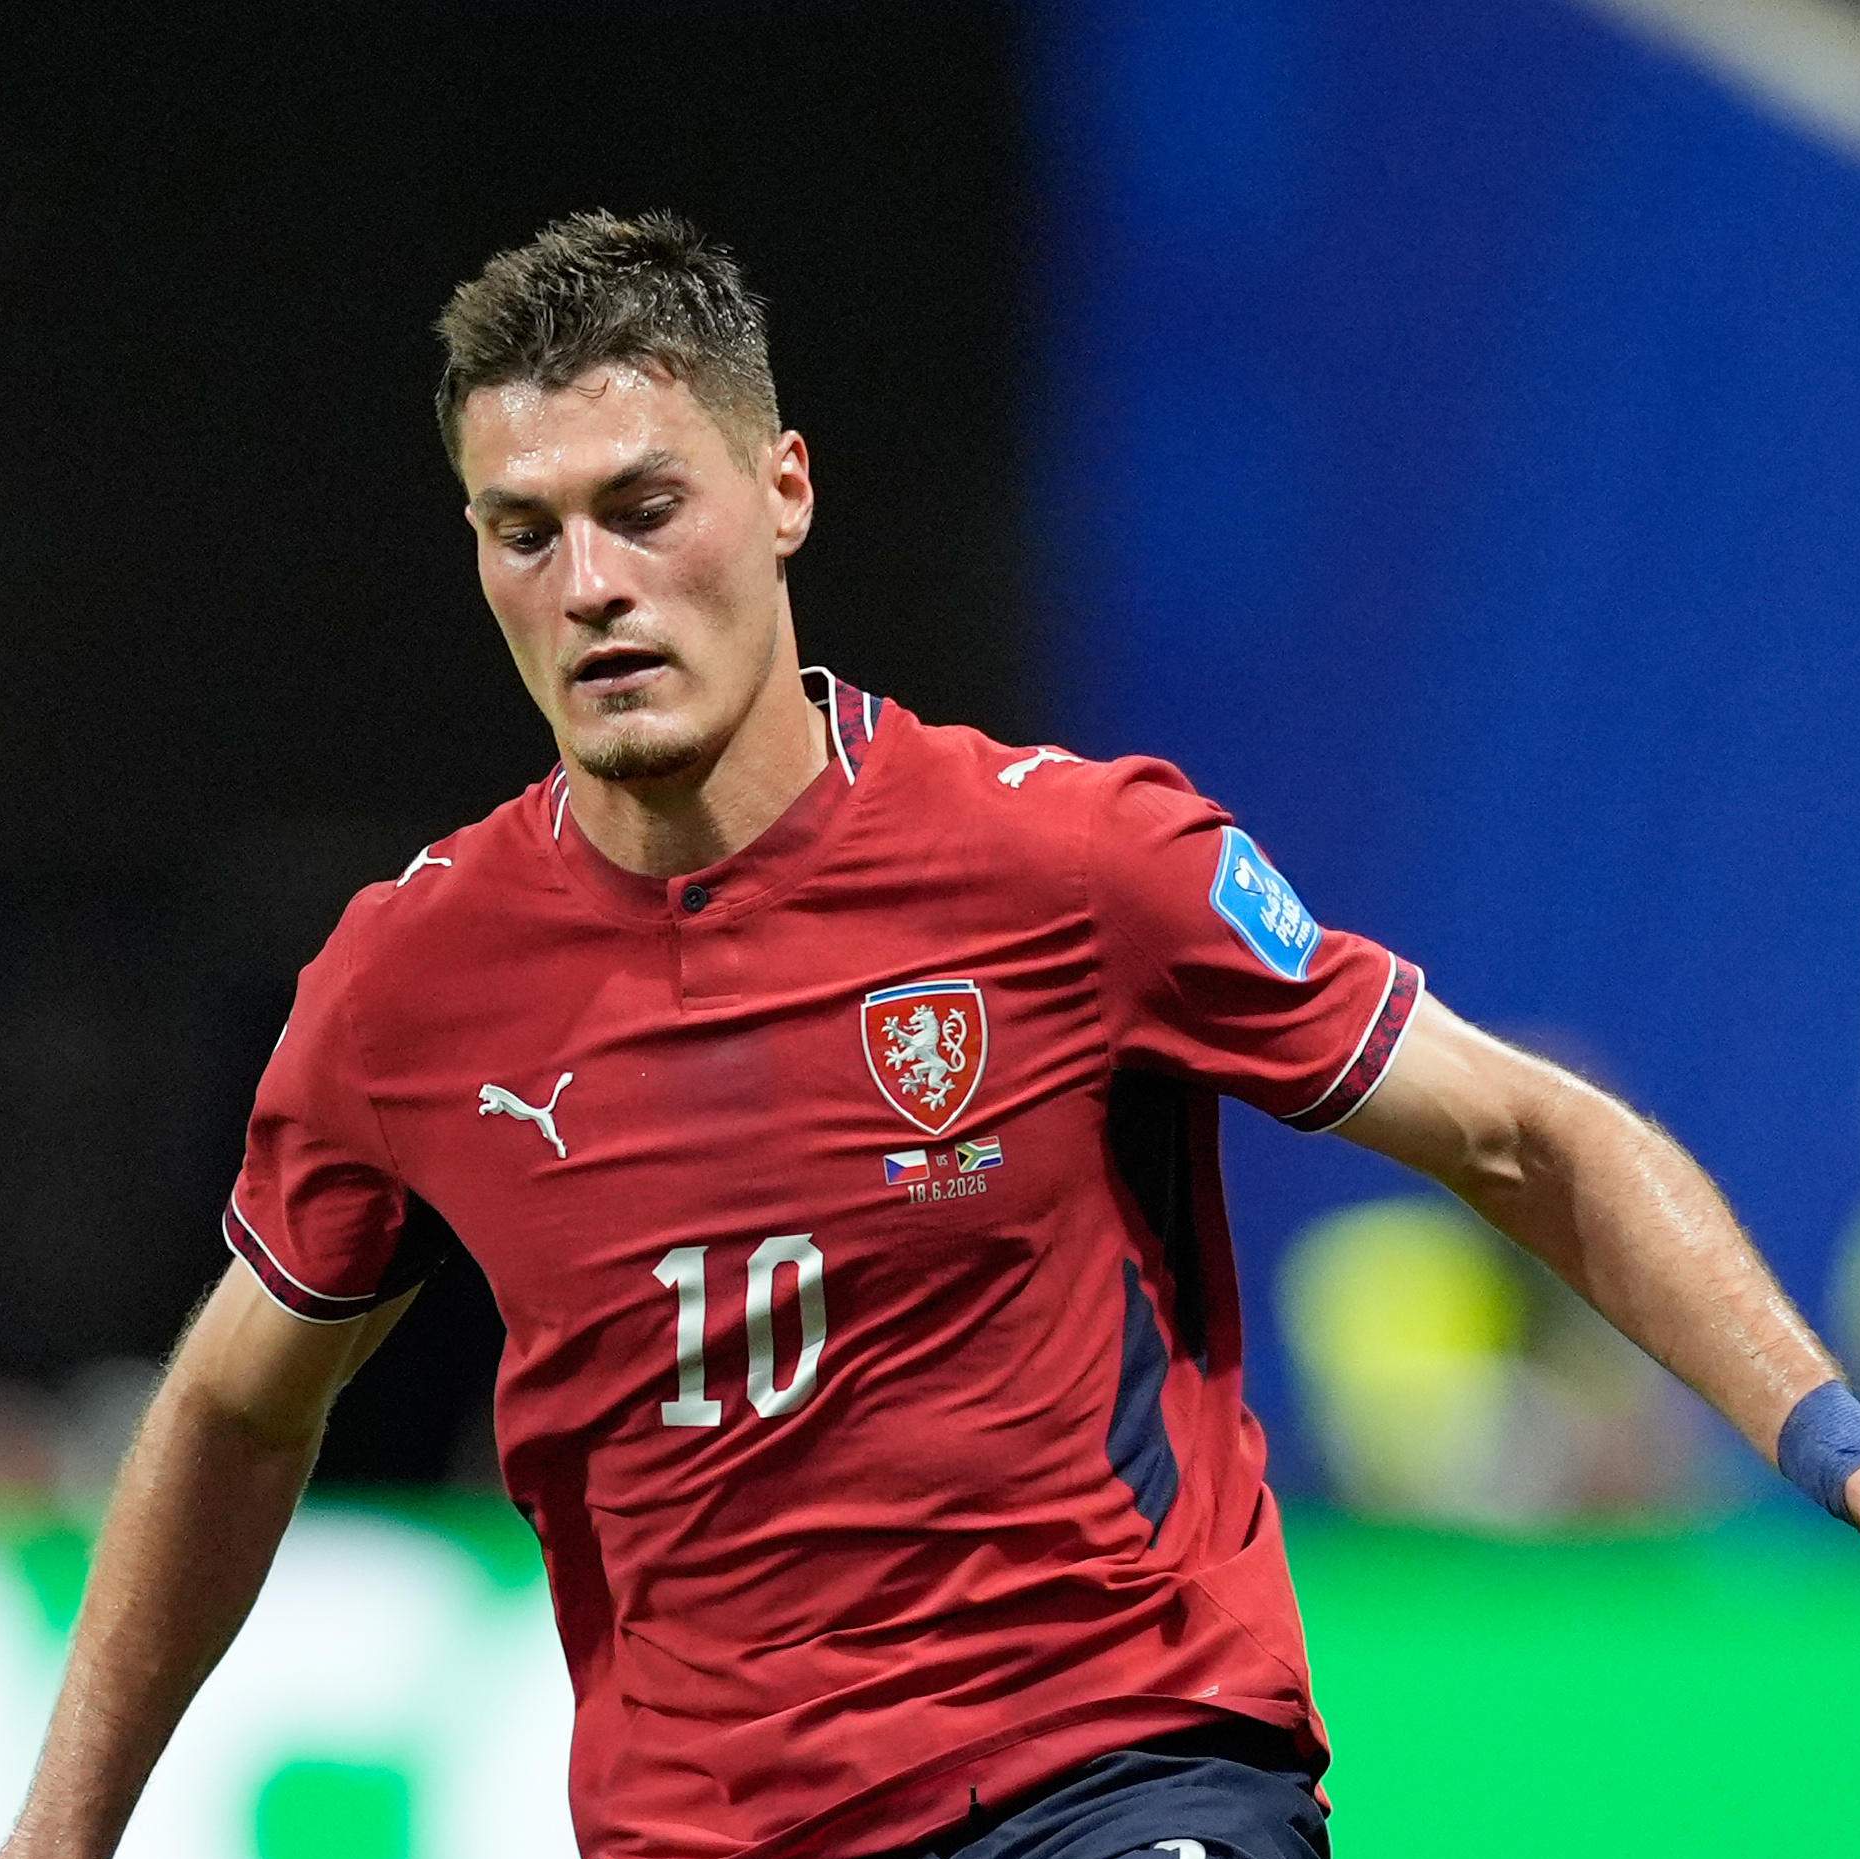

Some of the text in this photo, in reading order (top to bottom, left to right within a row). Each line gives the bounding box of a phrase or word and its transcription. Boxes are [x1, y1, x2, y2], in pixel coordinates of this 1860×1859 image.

[1294, 920, 1312, 949] FIFA
[907, 1174, 988, 1205] 18.6.2026
[651, 1232, 828, 1427] 10
